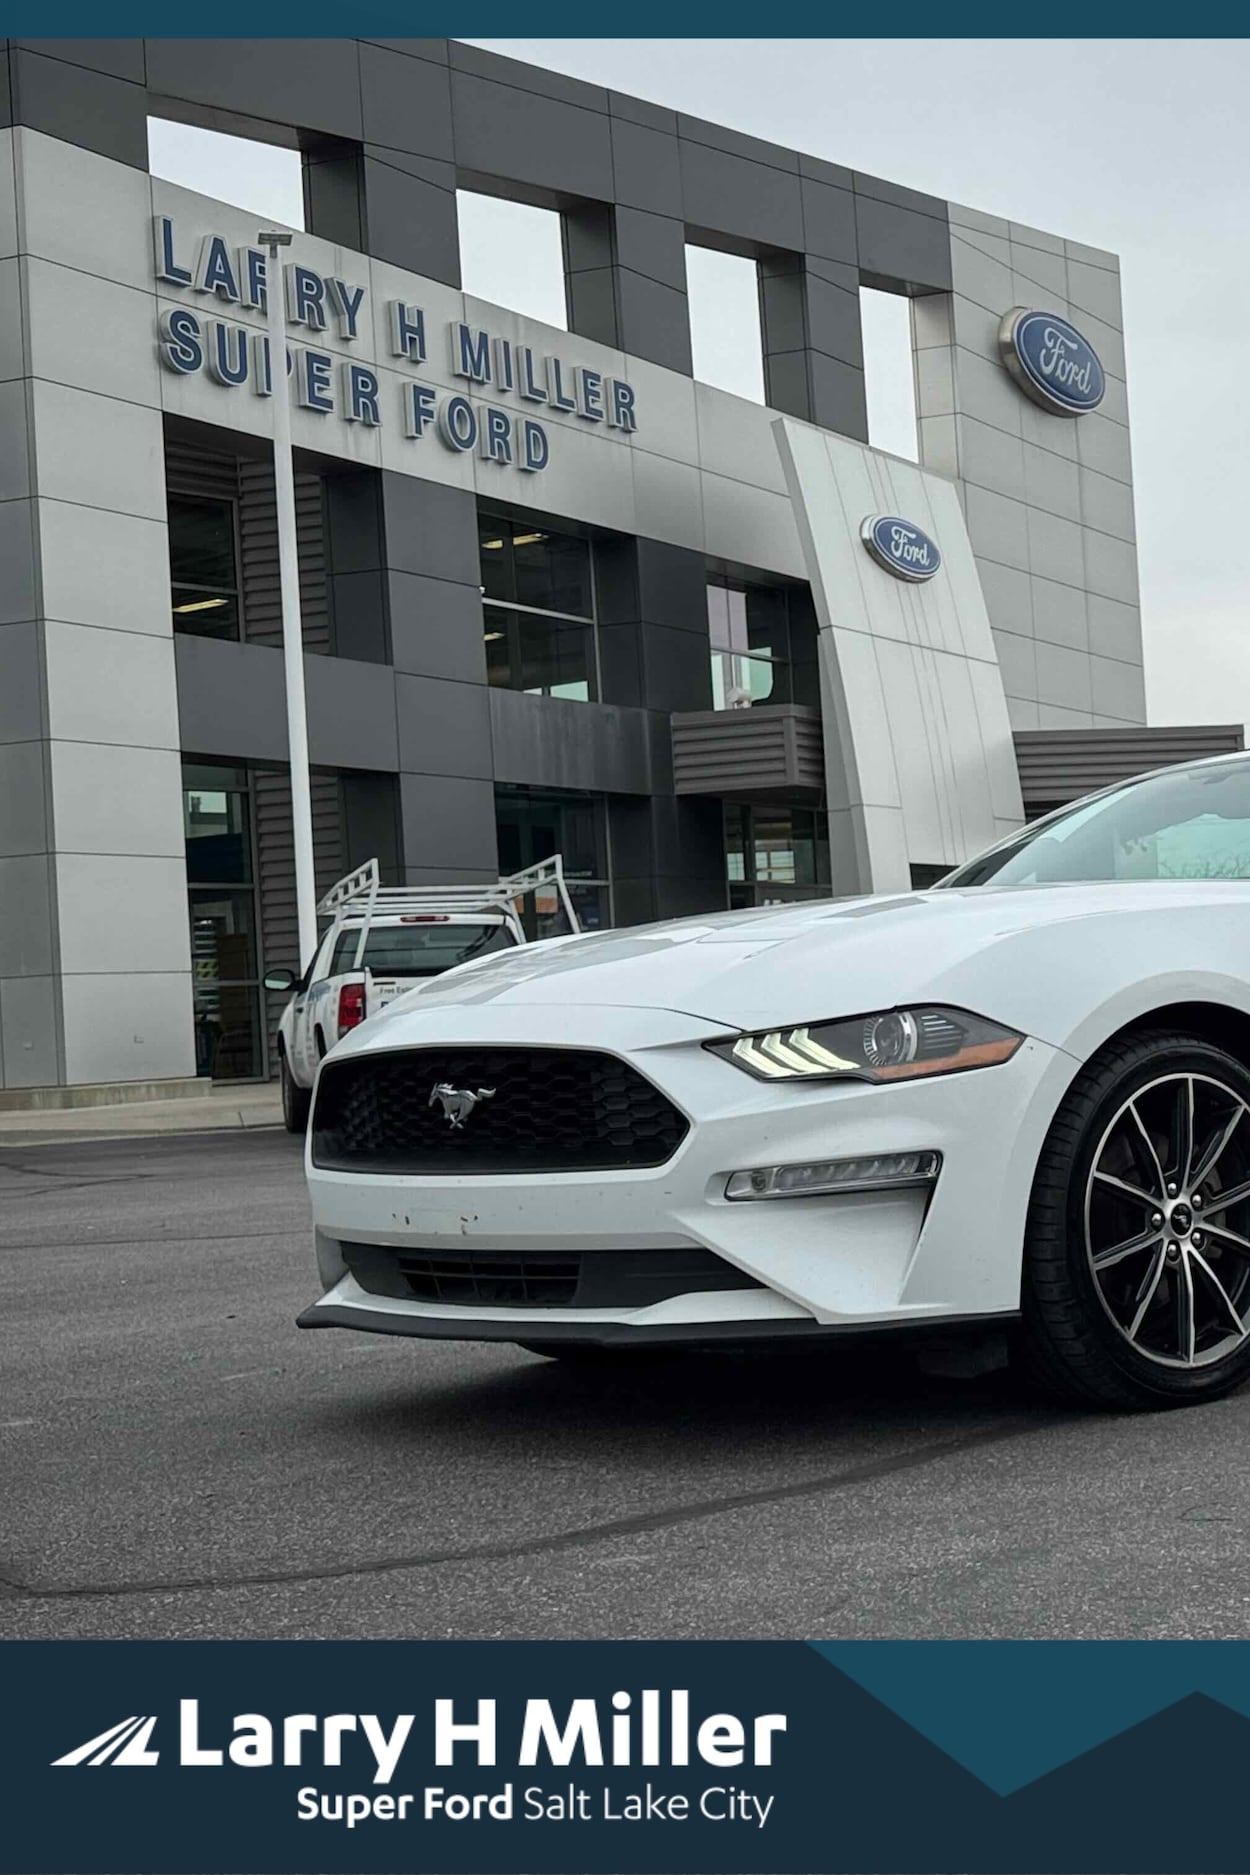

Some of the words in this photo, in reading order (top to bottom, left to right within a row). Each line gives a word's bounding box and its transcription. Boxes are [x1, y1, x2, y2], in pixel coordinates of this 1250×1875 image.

[394, 299, 426, 363] H
[455, 321, 637, 433] MILLER
[1039, 326, 1092, 395] Ford
[405, 381, 549, 472] FORD
[890, 526, 930, 567] Ford
